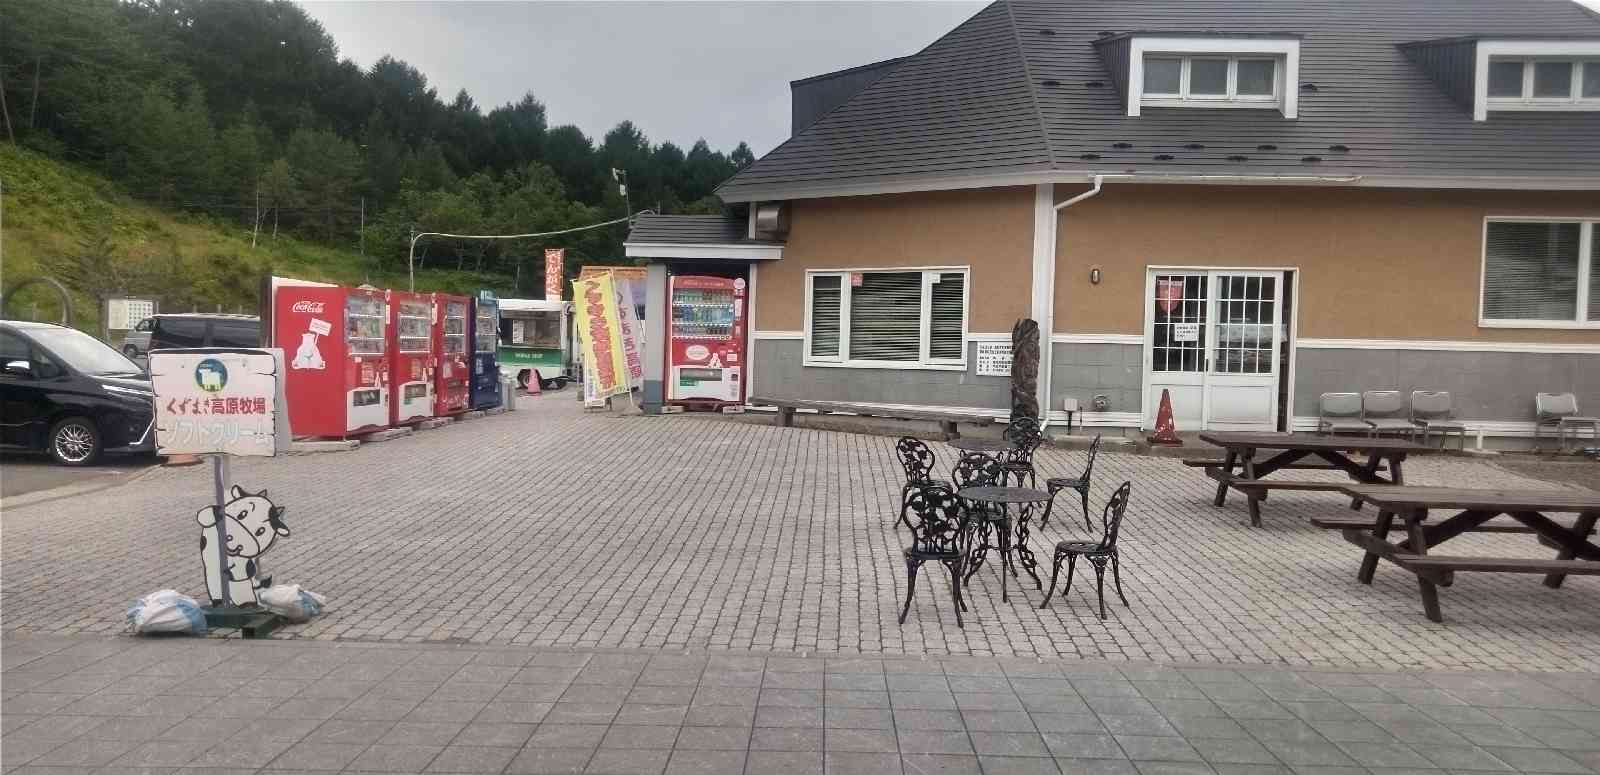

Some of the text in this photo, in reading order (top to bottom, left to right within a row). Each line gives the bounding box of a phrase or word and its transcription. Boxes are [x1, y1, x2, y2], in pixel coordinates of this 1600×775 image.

[166, 397, 267, 415] くずまき高原牧場
